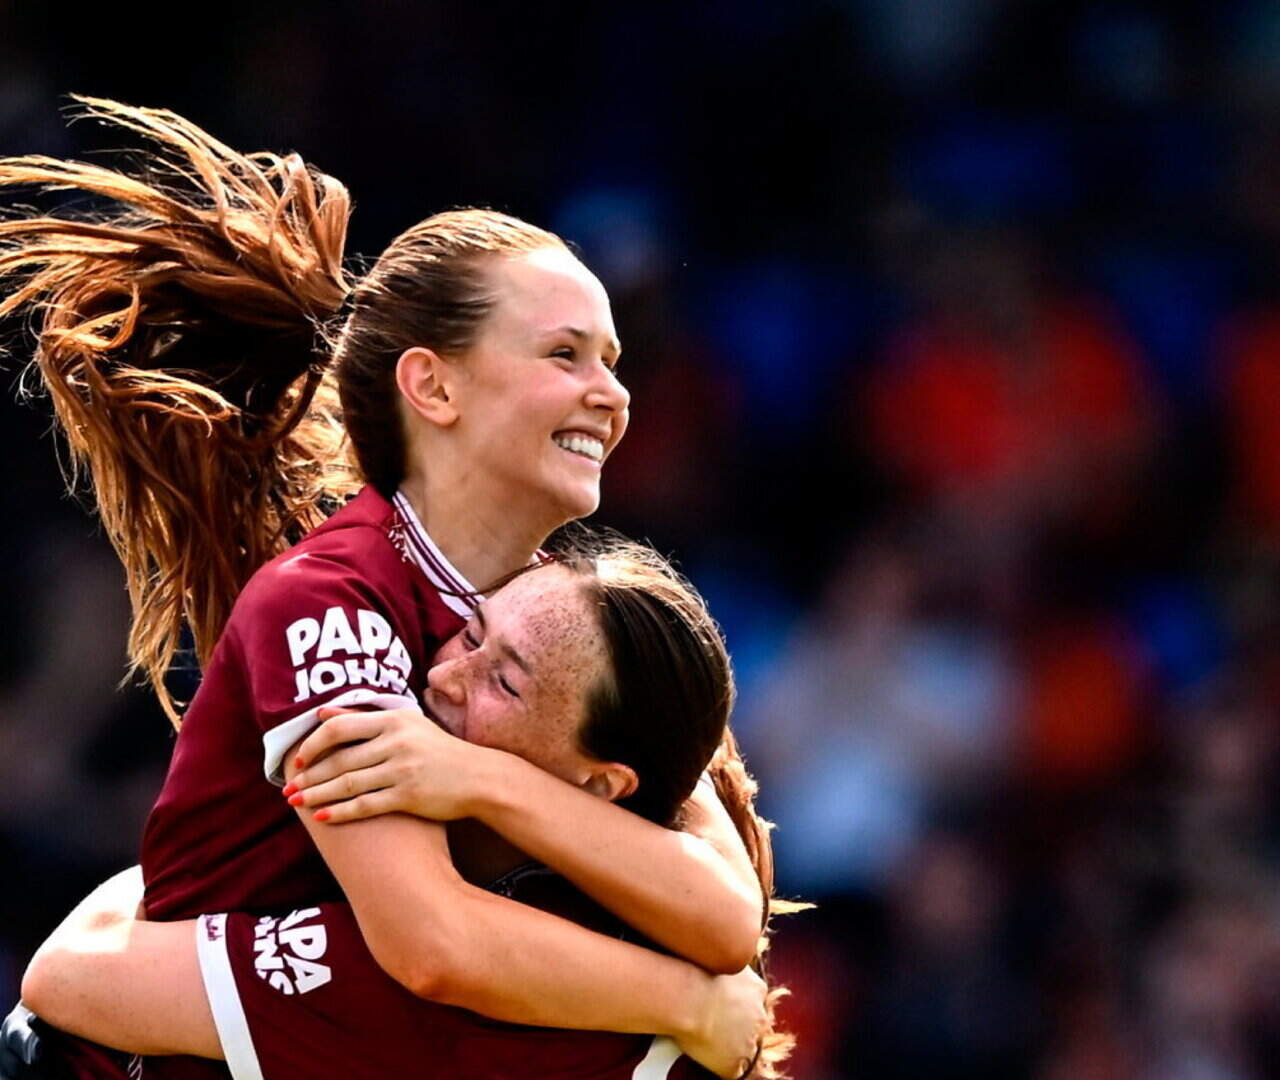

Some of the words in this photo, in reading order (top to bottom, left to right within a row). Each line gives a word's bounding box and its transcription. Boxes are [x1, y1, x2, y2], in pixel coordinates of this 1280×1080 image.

[286, 606, 412, 680] PAPA
[294, 657, 408, 703] JOHN
[278, 902, 332, 994] APA
